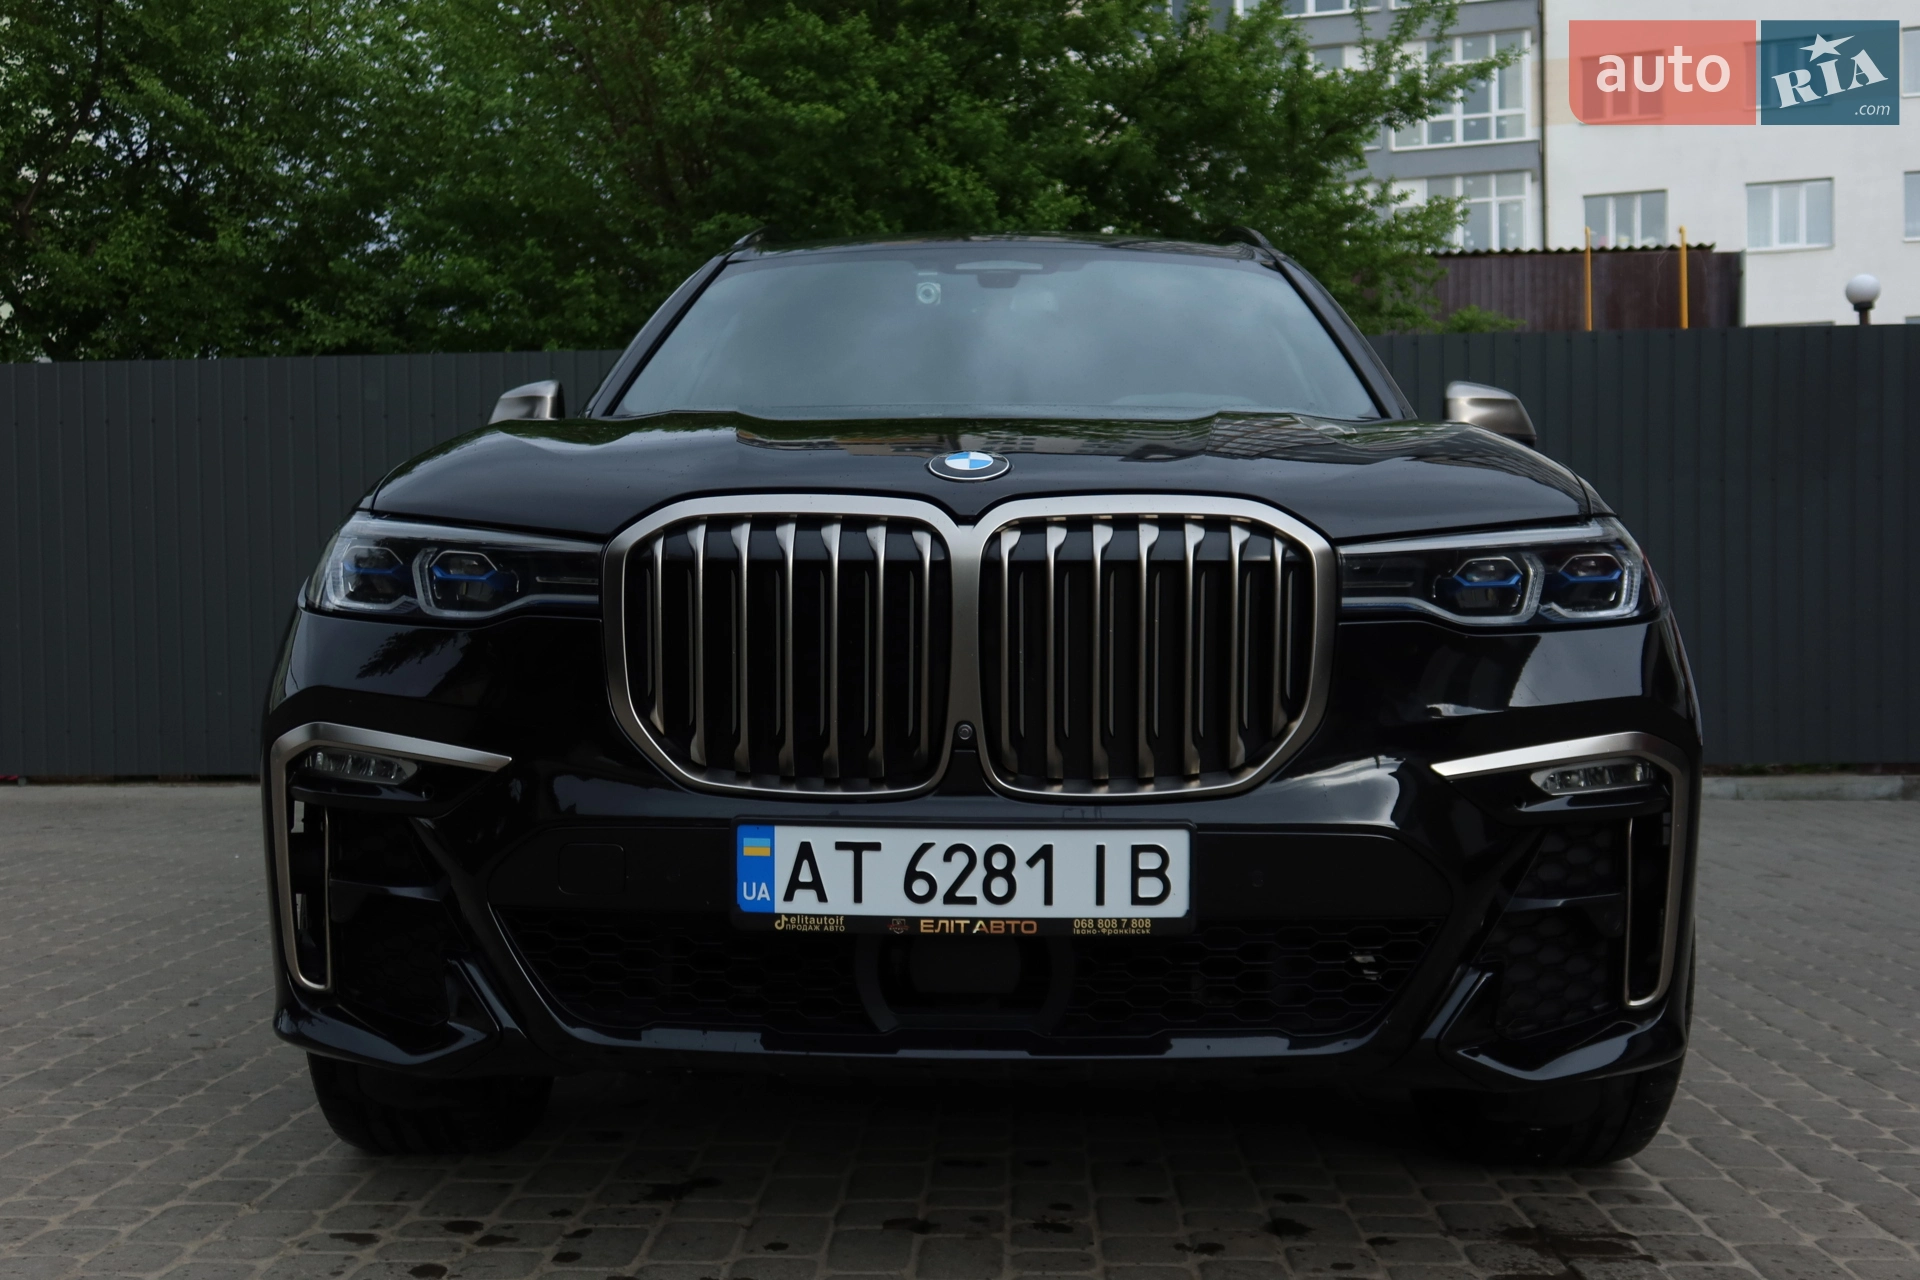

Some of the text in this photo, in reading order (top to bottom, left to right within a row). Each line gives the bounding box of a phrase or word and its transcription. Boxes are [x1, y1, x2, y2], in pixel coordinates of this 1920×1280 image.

[783, 841, 1172, 907] AT 6281 IB
[742, 881, 771, 902] UA
[789, 915, 845, 926] elitautoif
[1073, 918, 1151, 929] 068 808 7 808
[785, 924, 846, 932] ПРОДАЖ АВТО
[1073, 927, 1151, 936] Івано-Франківськ
